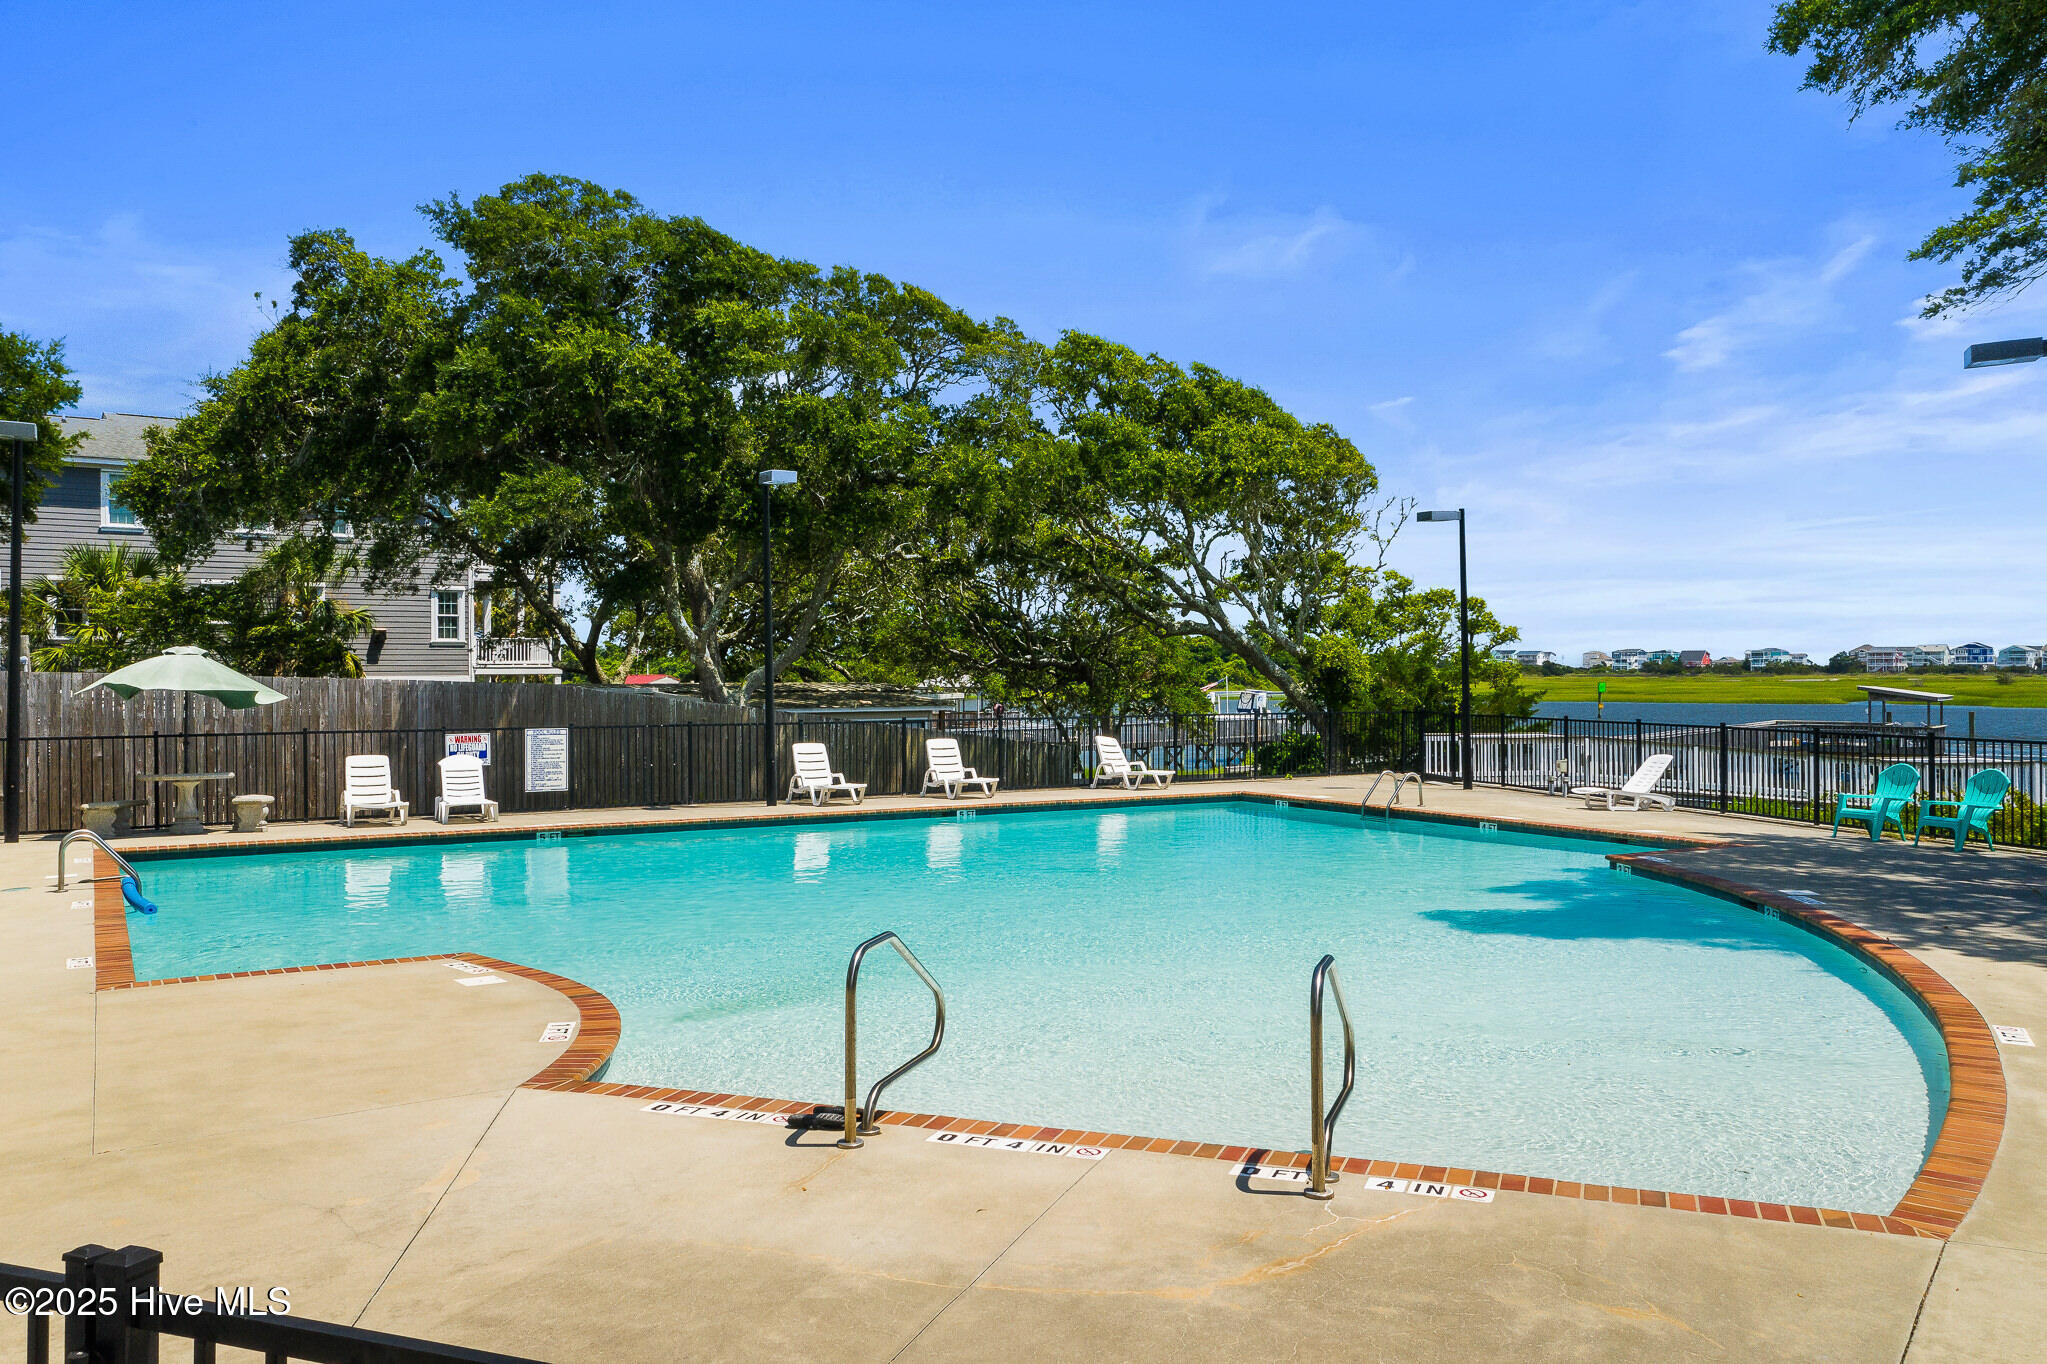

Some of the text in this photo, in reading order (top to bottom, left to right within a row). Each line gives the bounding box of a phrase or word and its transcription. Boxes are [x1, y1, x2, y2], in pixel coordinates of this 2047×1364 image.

[455, 735, 482, 743] WARNING
[459, 743, 487, 752] LIFEGUARD
[674, 1106, 707, 1114] FT
[736, 1112, 766, 1120] IN
[964, 1136, 998, 1146] FT
[1006, 1141, 1024, 1149] 4
[1036, 1144, 1067, 1154] IN
[1271, 1169, 1306, 1180] FT
[1376, 1180, 1395, 1190] 4
[1414, 1183, 1445, 1196] IN
